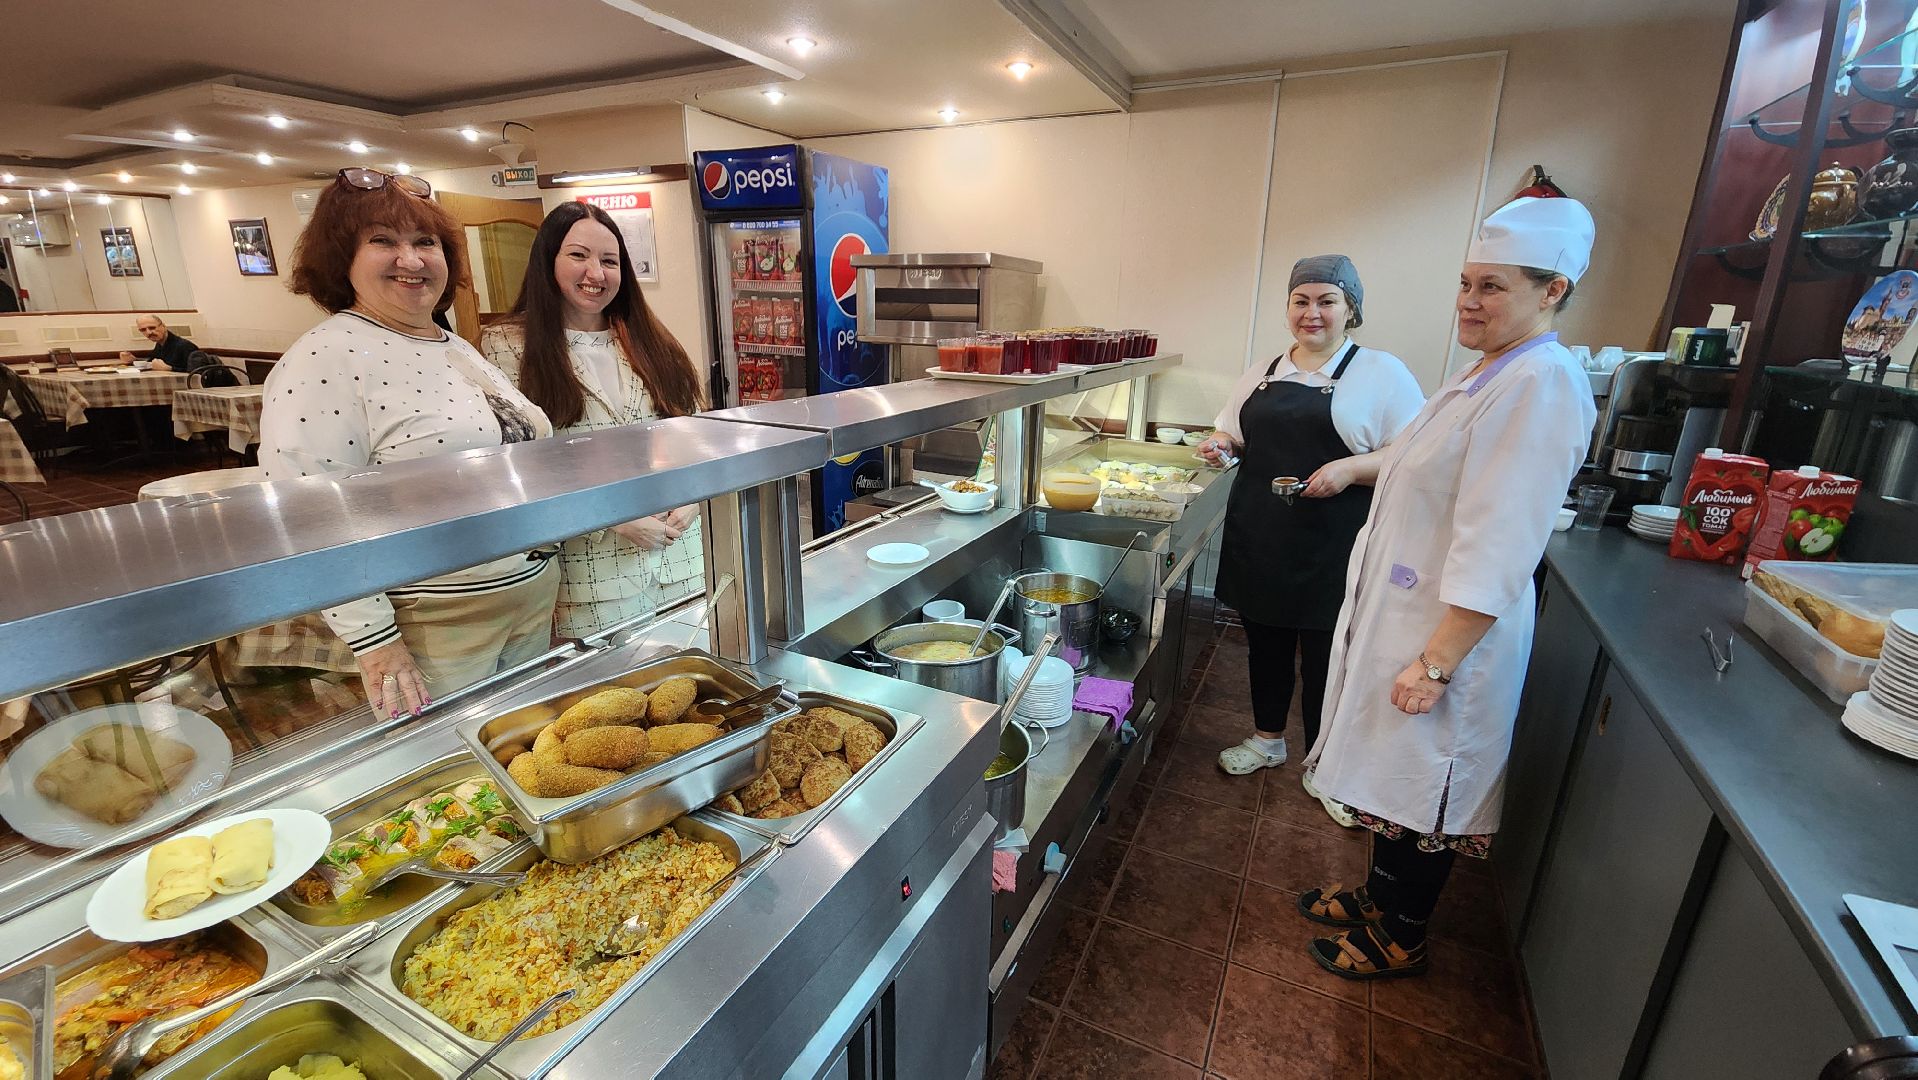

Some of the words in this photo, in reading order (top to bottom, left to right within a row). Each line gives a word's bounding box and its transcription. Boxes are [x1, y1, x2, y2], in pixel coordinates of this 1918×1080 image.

[505, 170, 534, 180] ВЫХОД
[734, 163, 793, 194] pepsi
[587, 194, 637, 209] МЕНЮ
[838, 329, 858, 351] pe
[1691, 488, 1755, 504] Любимый
[1799, 481, 1858, 499] Любимый
[1703, 516, 1728, 525] СОК
